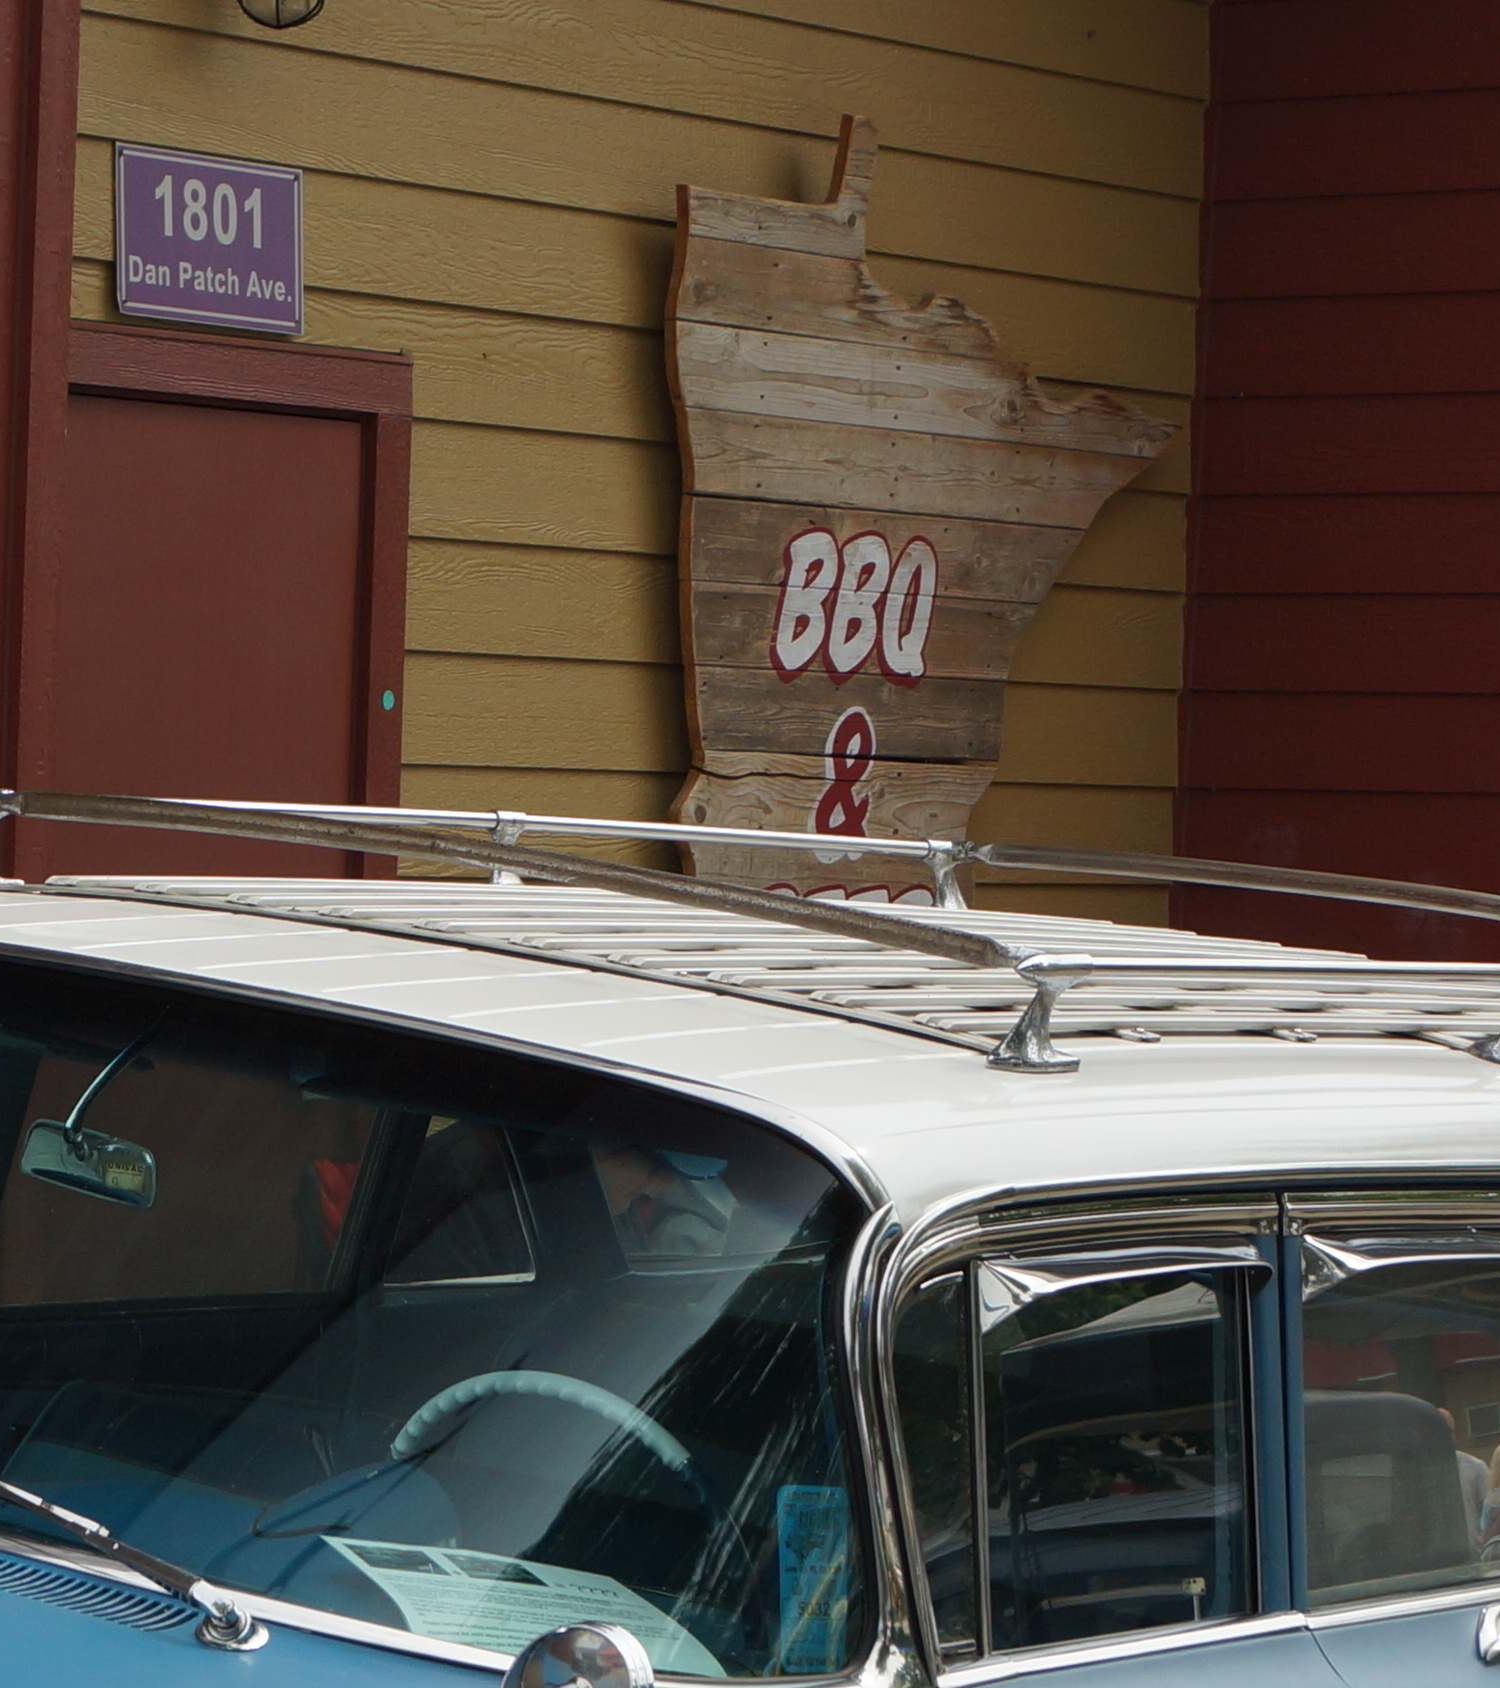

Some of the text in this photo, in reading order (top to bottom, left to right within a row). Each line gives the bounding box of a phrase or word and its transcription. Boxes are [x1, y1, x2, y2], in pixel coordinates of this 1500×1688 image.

[154, 174, 262, 249] 1801
[128, 255, 292, 303] Dan Patch Ave.
[770, 526, 938, 688] BBQ
[808, 706, 876, 864] &
